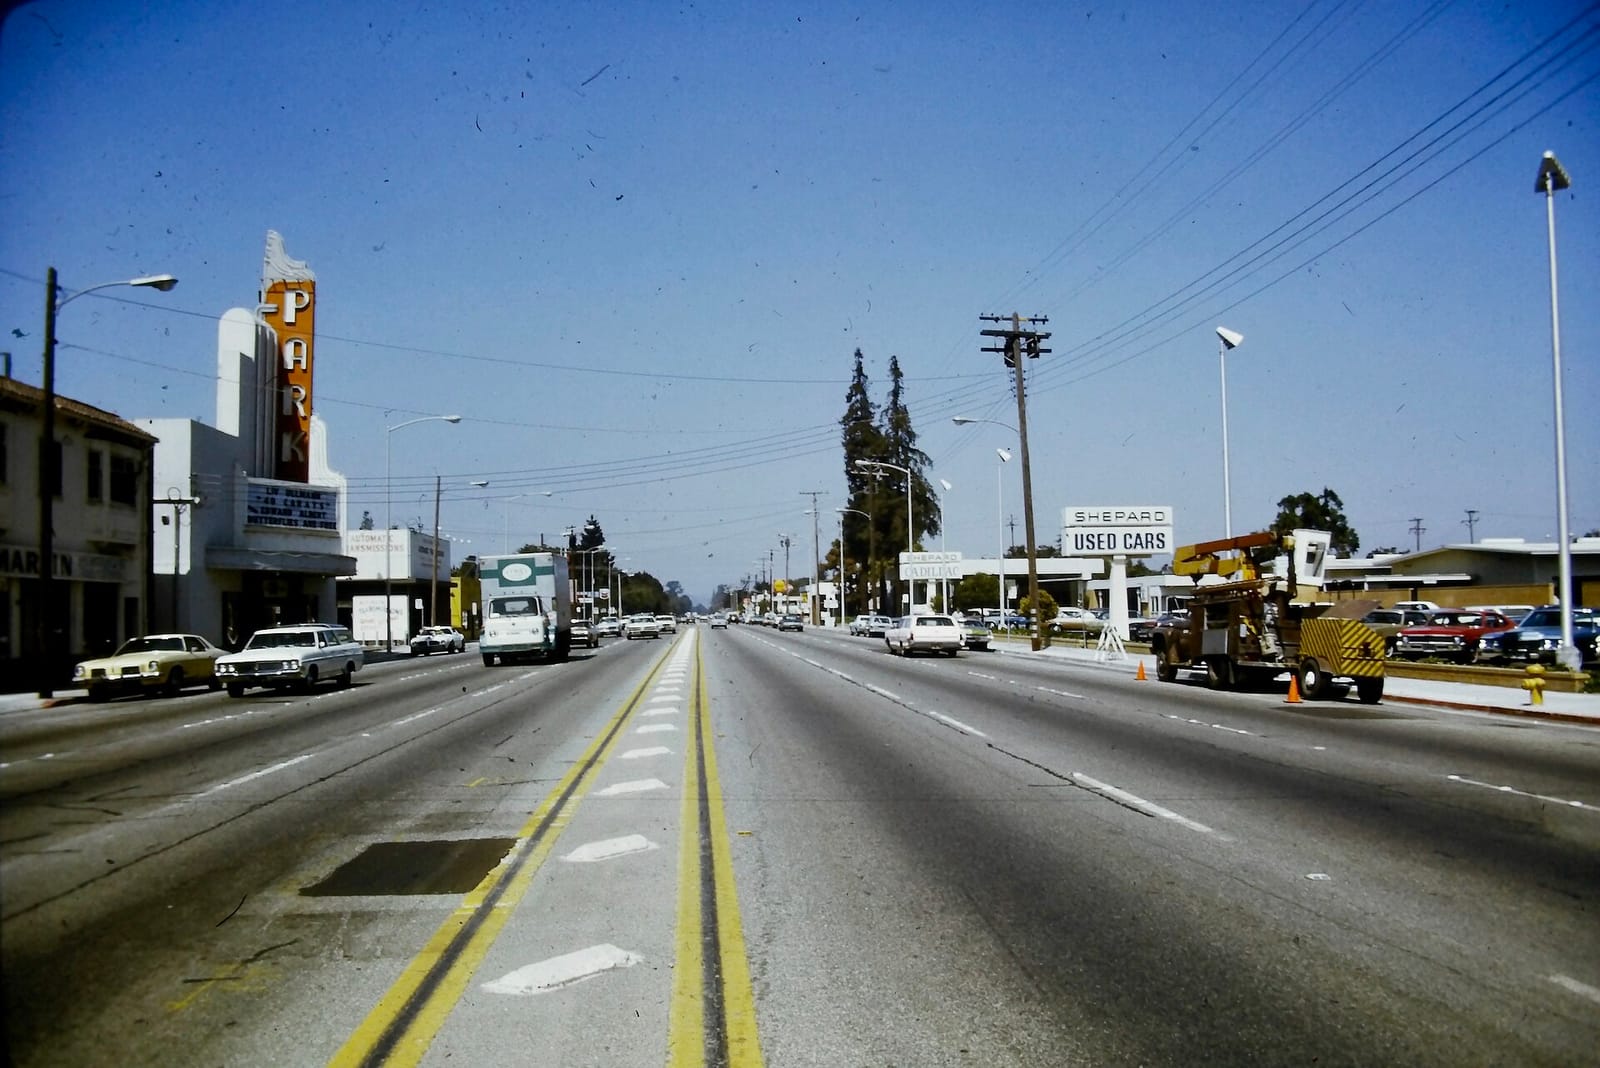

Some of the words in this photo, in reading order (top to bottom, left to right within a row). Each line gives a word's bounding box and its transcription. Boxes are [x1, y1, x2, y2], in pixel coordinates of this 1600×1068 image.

[282, 289, 310, 463] PARK
[1074, 511, 1165, 522] SHEPARD
[351, 534, 394, 543] AUTOMATC
[1075, 532, 1117, 551] USED
[1123, 532, 1165, 550] CARS
[0, 548, 72, 577] MARIN
[904, 566, 960, 577] CADILLAC
